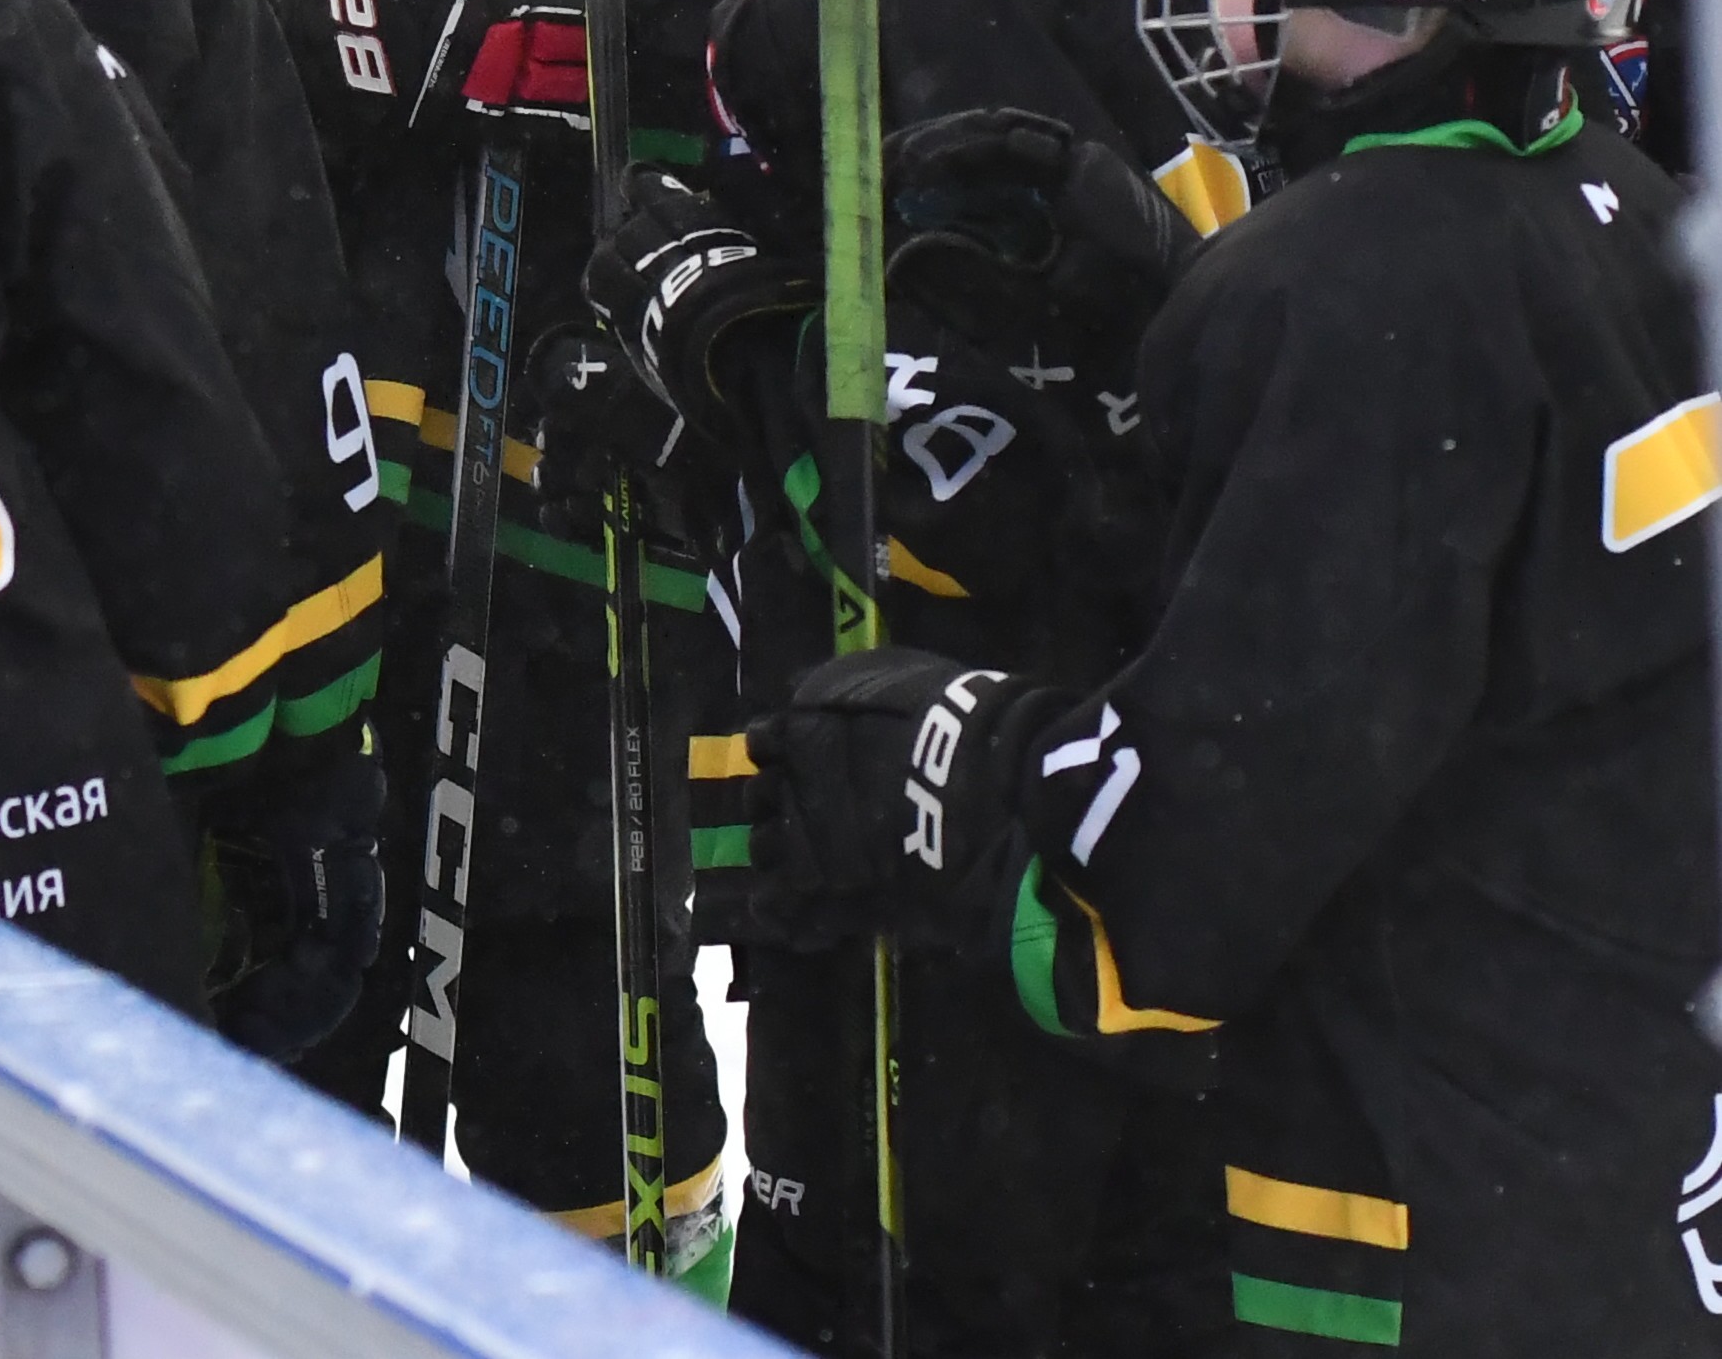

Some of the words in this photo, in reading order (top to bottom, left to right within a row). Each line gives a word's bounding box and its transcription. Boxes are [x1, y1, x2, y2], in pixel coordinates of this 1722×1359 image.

[626, 725, 642, 777] FLEX
[629, 783, 643, 811] 20
[409, 642, 486, 1063] CCM
